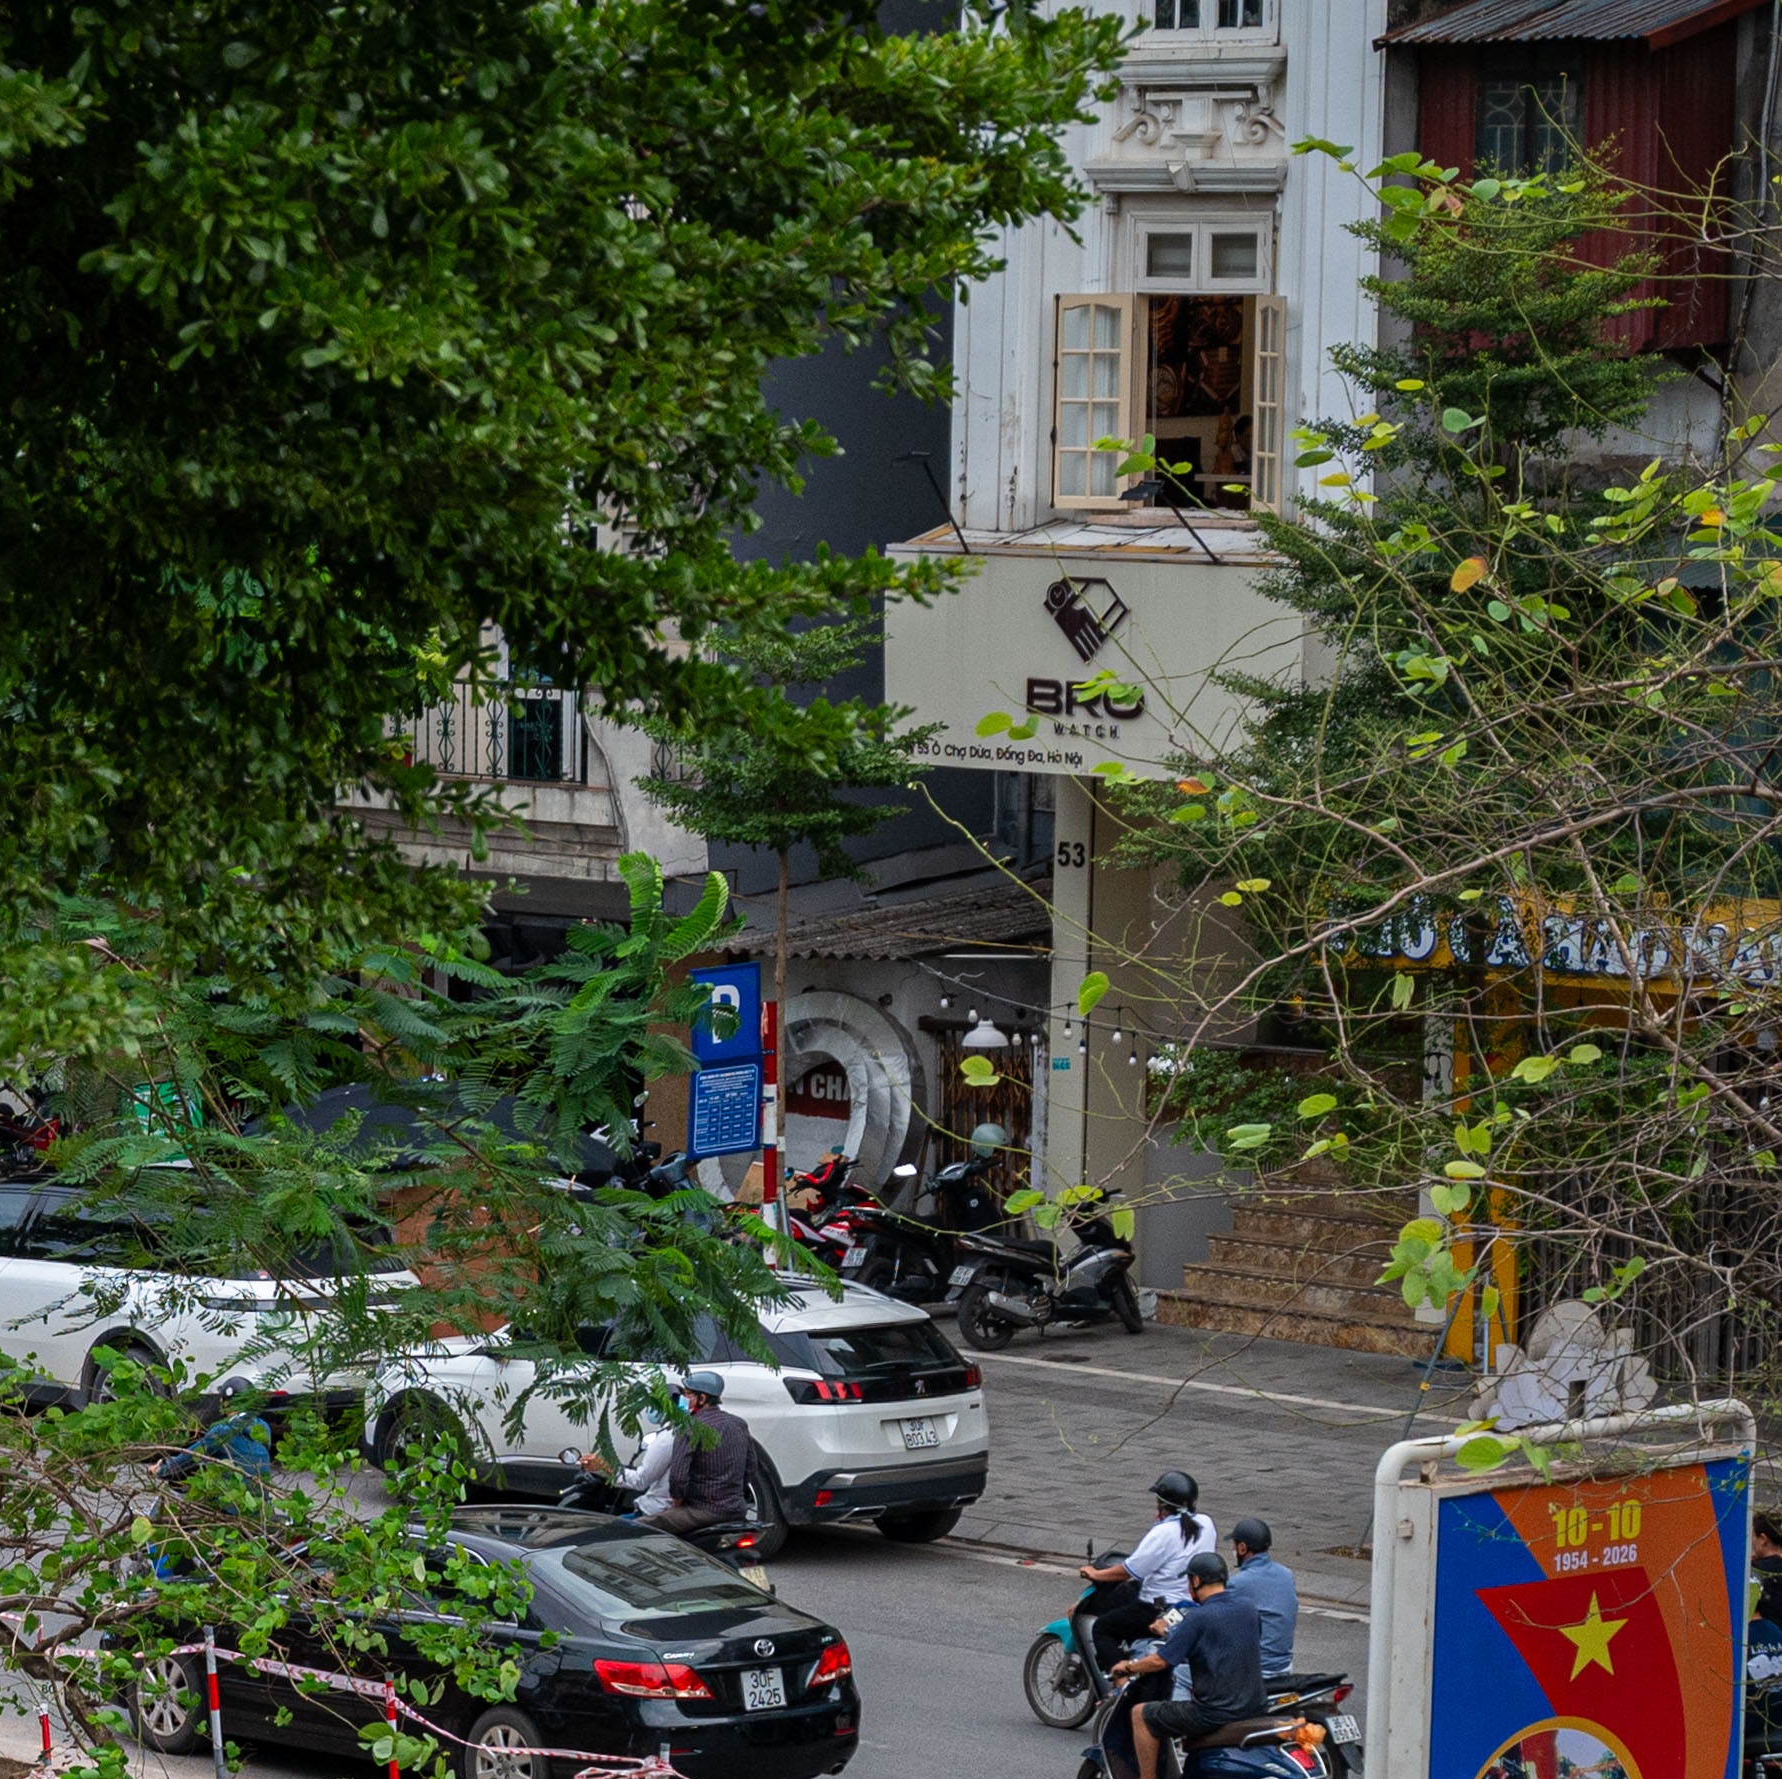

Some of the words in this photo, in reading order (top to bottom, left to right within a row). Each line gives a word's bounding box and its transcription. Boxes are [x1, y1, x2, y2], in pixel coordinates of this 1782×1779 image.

[1026, 677, 1145, 720] BRO
[1053, 722, 1121, 738] WATCH
[944, 743, 967, 761] Chợ
[996, 744, 1025, 765] Đống
[1057, 841, 1085, 868] 53
[711, 984, 741, 1044] P
[1554, 1550, 1588, 1572] 1954
[1602, 1544, 1638, 1566] 2026
[750, 1670, 774, 1689] 30F
[749, 1688, 782, 1708] 2425
